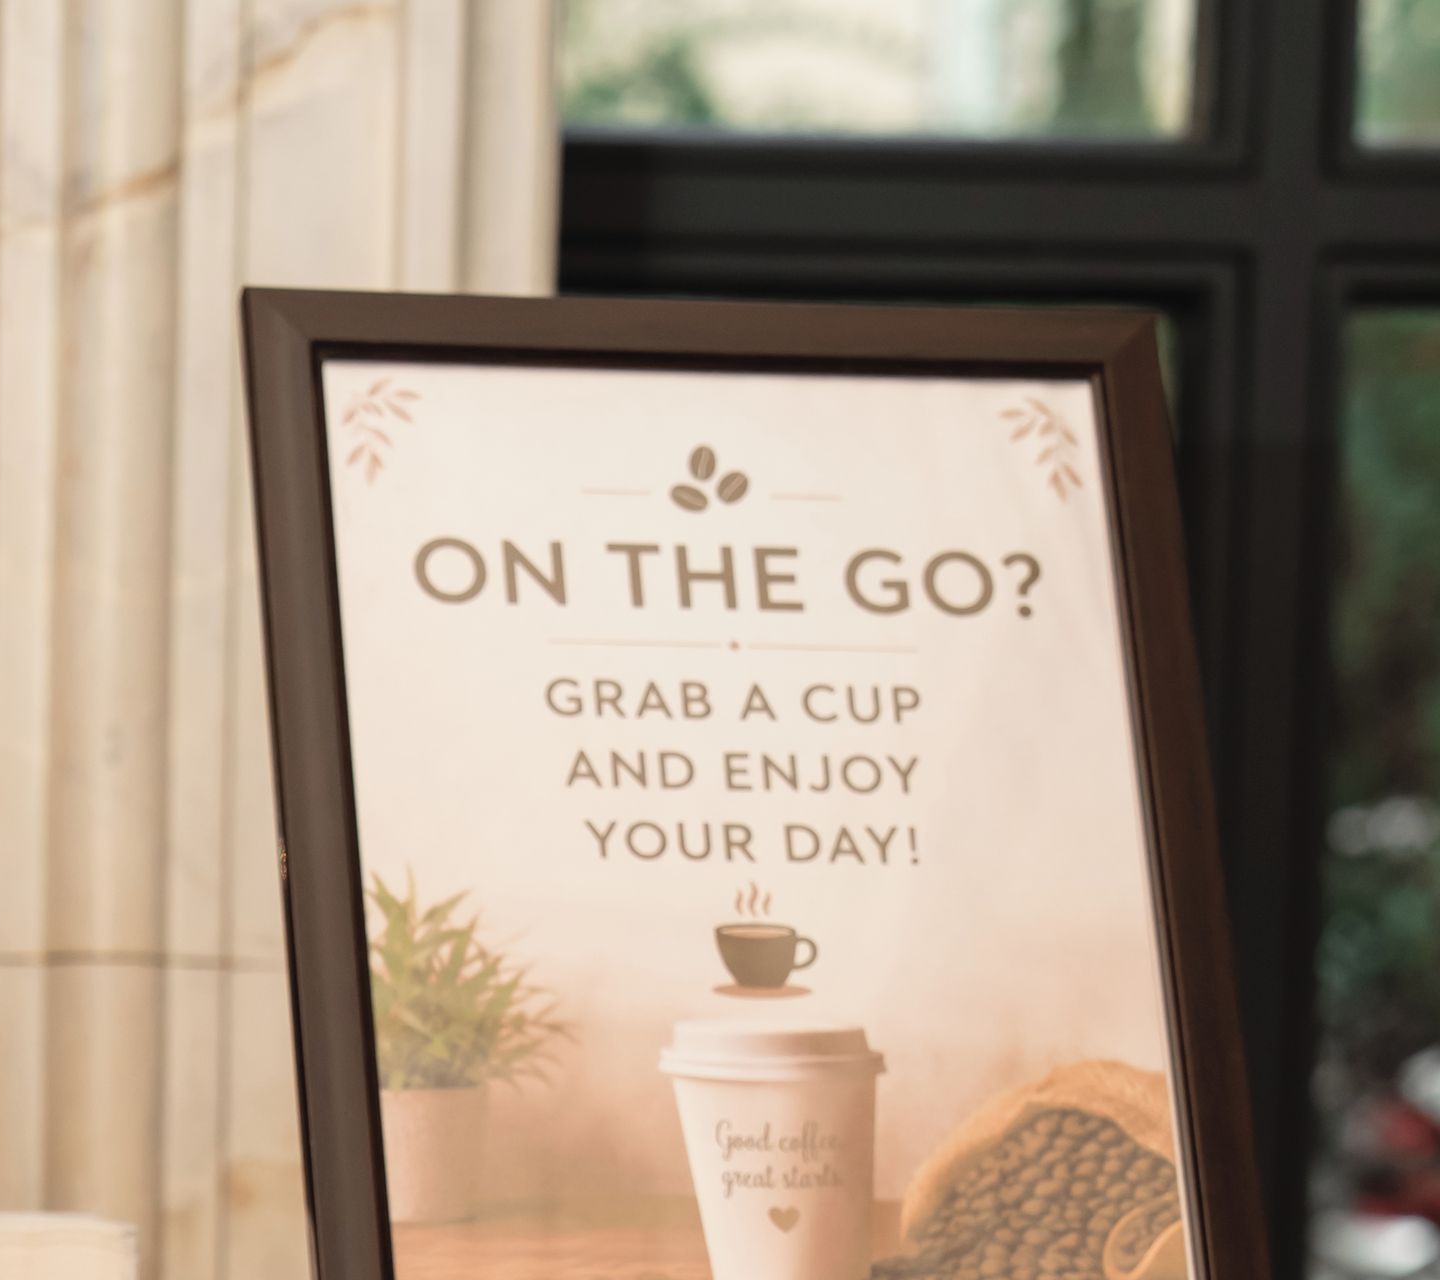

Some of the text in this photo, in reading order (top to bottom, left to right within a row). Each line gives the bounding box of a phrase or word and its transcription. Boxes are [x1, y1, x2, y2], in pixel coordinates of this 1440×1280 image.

[413, 536, 1042, 619] ON THE GO?
[545, 677, 921, 724] GRAB A CUP
[567, 749, 919, 795] AND ENJOY
[585, 820, 919, 865] YOUR DAY!
[715, 1118, 774, 1161] Good
[721, 1165, 776, 1199] great
